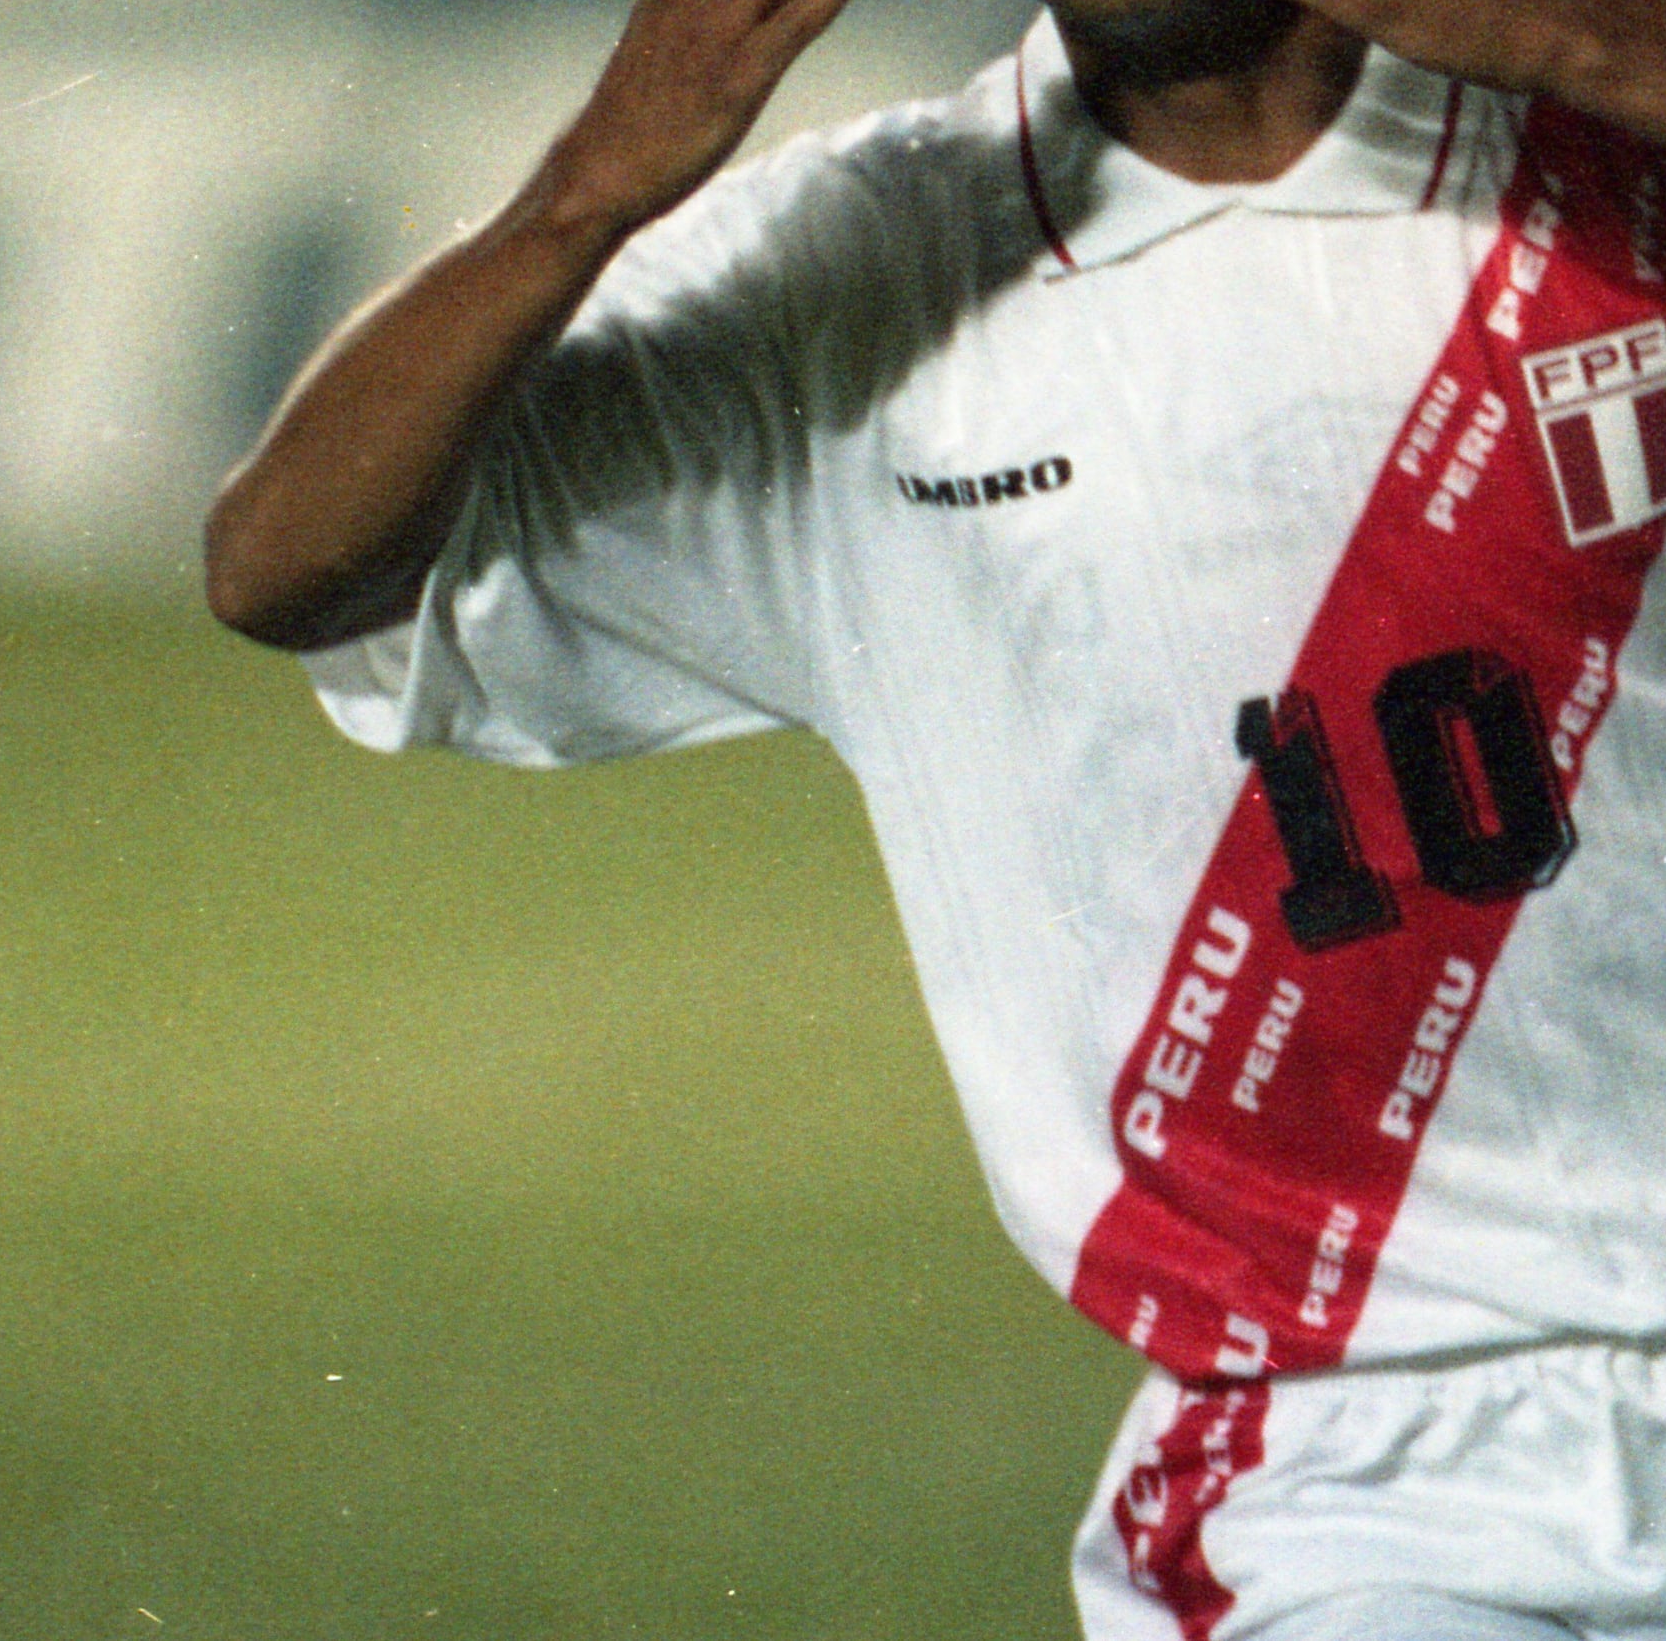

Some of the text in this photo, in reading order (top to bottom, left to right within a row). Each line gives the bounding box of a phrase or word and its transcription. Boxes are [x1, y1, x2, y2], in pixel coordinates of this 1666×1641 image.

[1396, 374, 1461, 479] PERU
[1533, 329, 1663, 401] FPF
[1424, 388, 1510, 535] PERU
[1550, 636, 1609, 773] PERU
[1234, 645, 1580, 955] 10
[1123, 905, 1253, 1161] PERU
[1233, 977, 1305, 1114] PERU
[1378, 956, 1477, 1141] PERU
[1299, 1203, 1359, 1329] PERU
